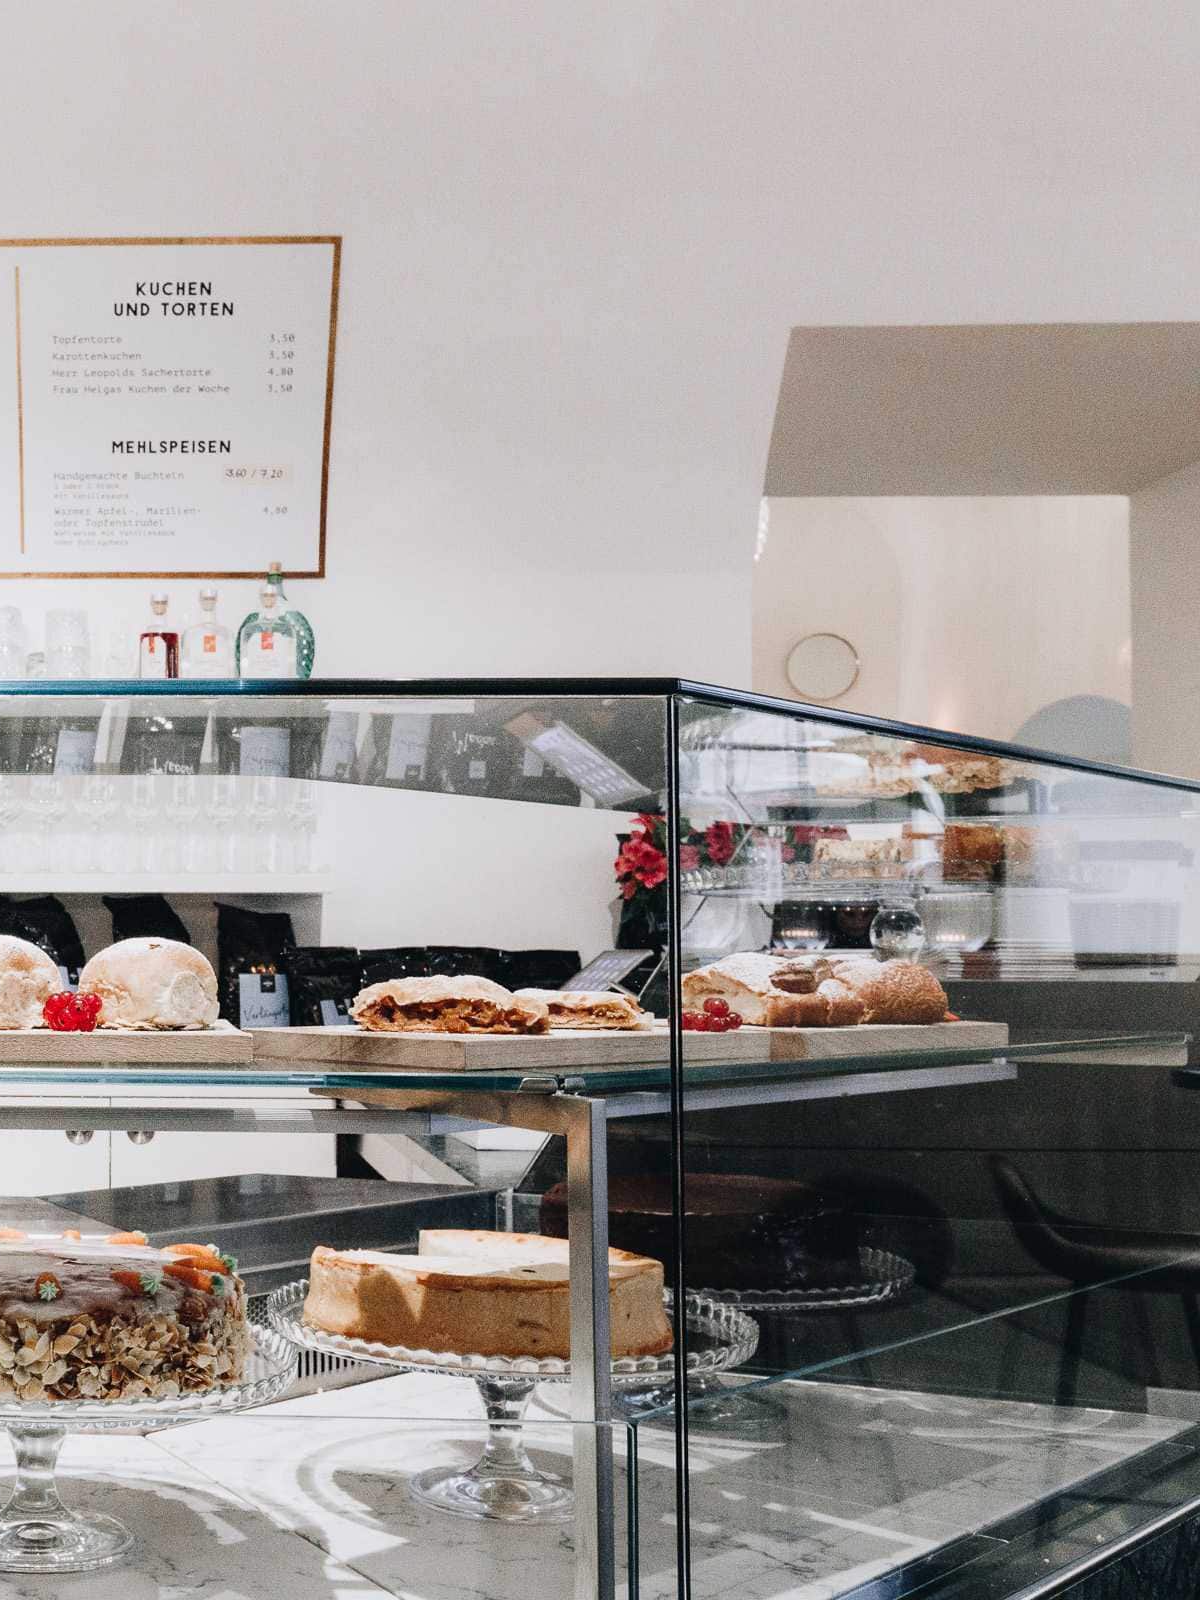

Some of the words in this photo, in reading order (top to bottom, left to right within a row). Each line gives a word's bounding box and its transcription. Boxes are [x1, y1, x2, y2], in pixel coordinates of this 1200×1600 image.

[135, 281, 212, 296] KUCHEN
[113, 302, 150, 317] UND
[160, 301, 234, 317] TORTEN
[51, 335, 123, 346] Topfentorte
[51, 350, 143, 360] Karottenkuchen
[51, 367, 78, 377] Herr
[140, 366, 212, 377] Sachertorte
[51, 383, 79, 394] Frau
[128, 382, 168, 393] Kuchen
[172, 382, 193, 393] der
[198, 382, 231, 393] Woche
[111, 440, 231, 454] MEHLSPEISEN
[52, 471, 128, 481] Handgemachte
